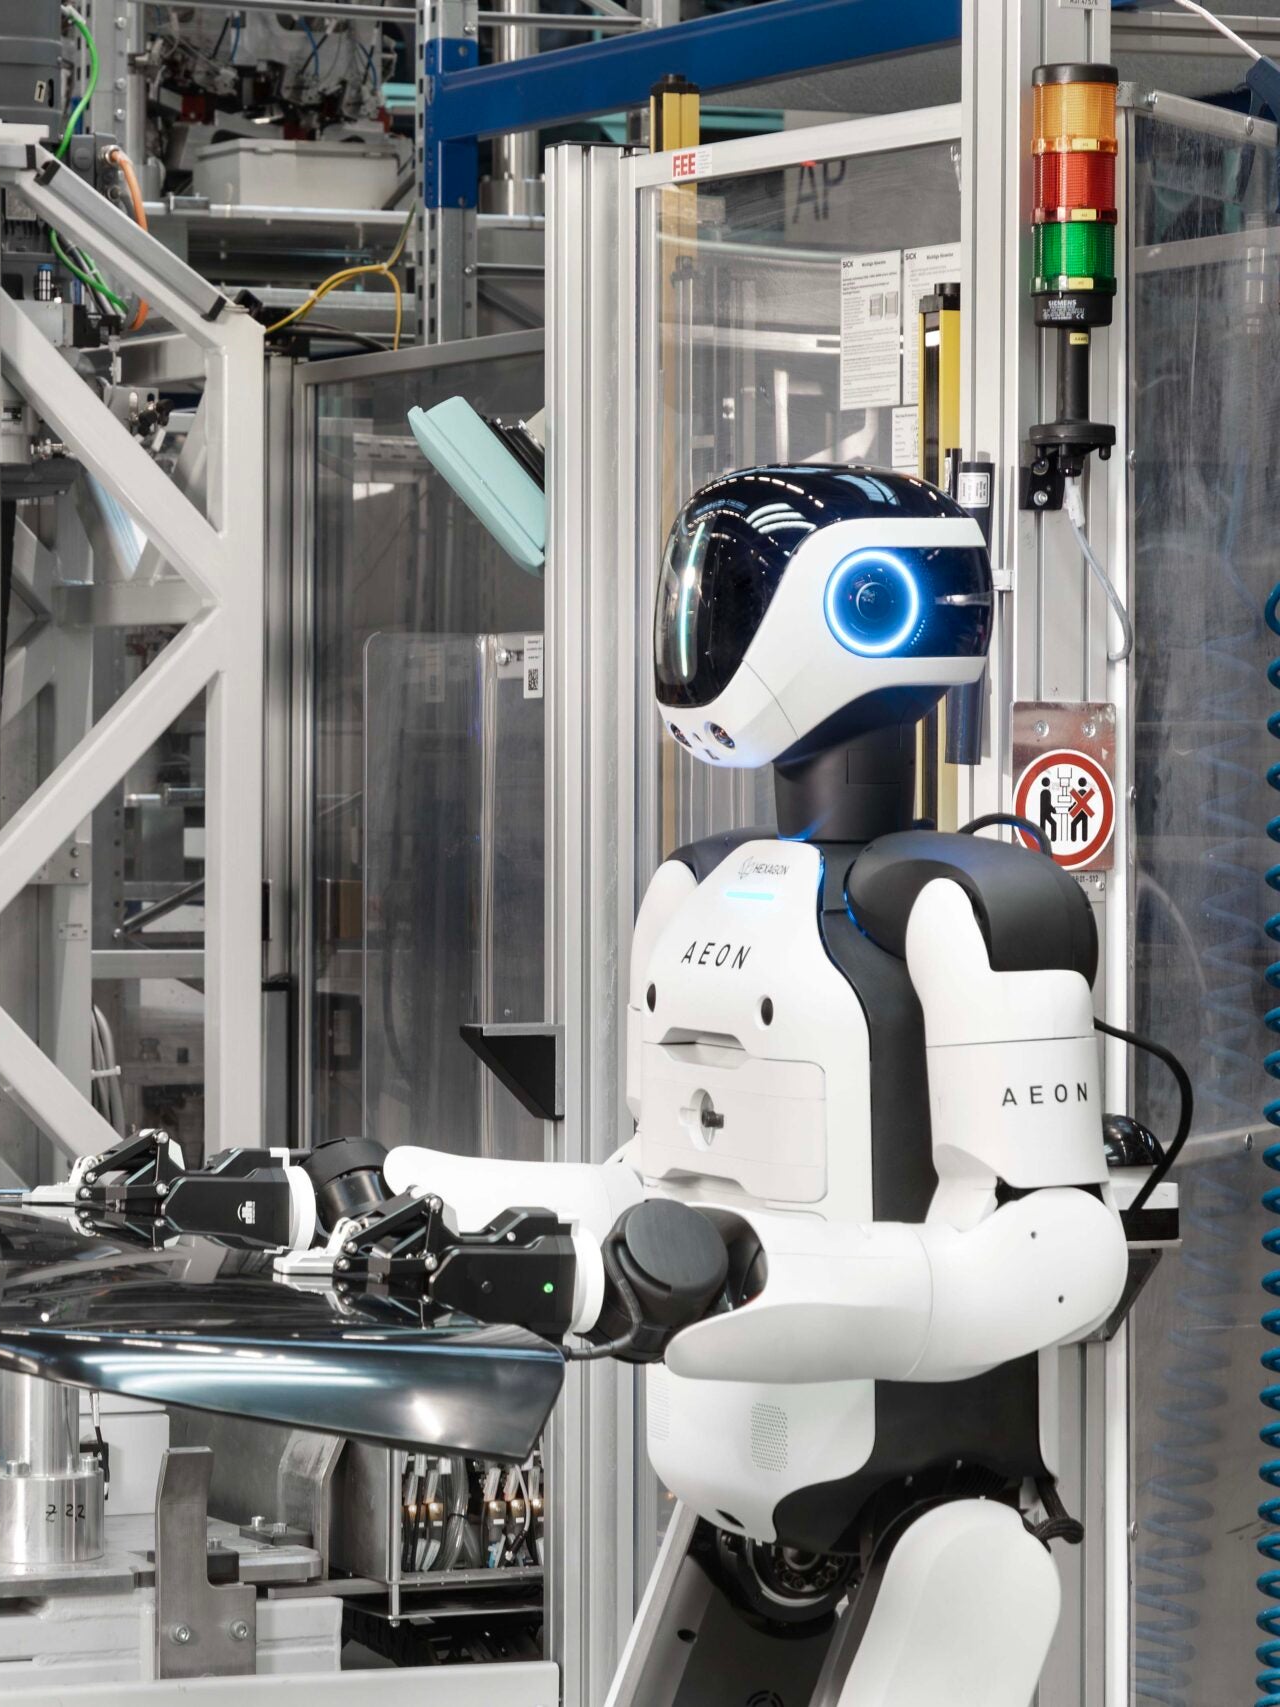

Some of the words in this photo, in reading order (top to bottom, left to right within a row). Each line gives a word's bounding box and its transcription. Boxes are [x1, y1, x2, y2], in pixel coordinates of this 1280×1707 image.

[752, 862, 790, 875] HEXAGON
[680, 940, 752, 970] AEON
[1001, 1082, 1088, 1106] AEON
